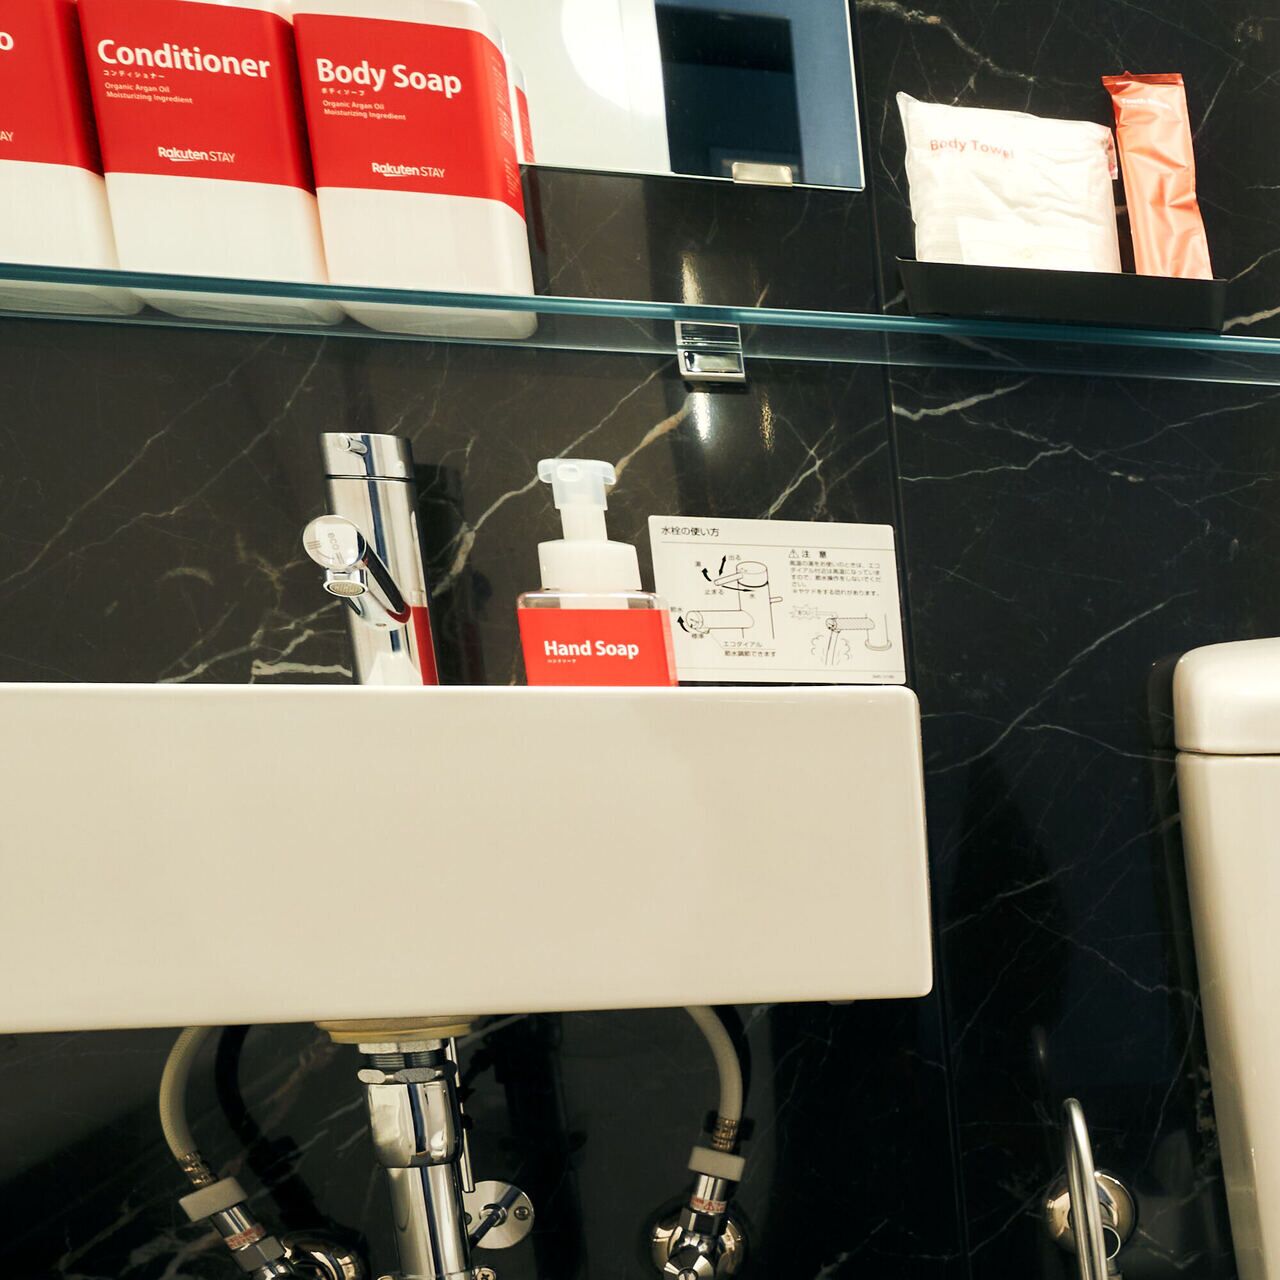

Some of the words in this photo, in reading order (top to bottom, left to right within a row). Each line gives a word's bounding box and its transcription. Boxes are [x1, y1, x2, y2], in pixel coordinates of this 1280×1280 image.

[97, 39, 271, 79] Conditioner
[103, 69, 165, 80] コンディショナー
[316, 57, 386, 92] Body
[392, 64, 462, 99] Soap
[104, 81, 133, 92] Organic
[135, 84, 157, 93] Argan
[159, 85, 170, 93] Oil
[106, 91, 153, 102] Moisturizing
[154, 94, 193, 104] Ingredient
[322, 99, 350, 109] Organic
[351, 102, 372, 111] Argan
[324, 108, 368, 119] Moisturizing
[369, 111, 407, 121] Ingredient
[930, 138, 967, 153] Body
[158, 146, 208, 162] Rakuten
[210, 151, 236, 163] STAY
[371, 162, 420, 178] Rakuten
[420, 166, 446, 178] STAY
[661, 526, 720, 537] 水栓の使い方
[543, 640, 593, 656] Hand
[594, 640, 640, 660] Soap
